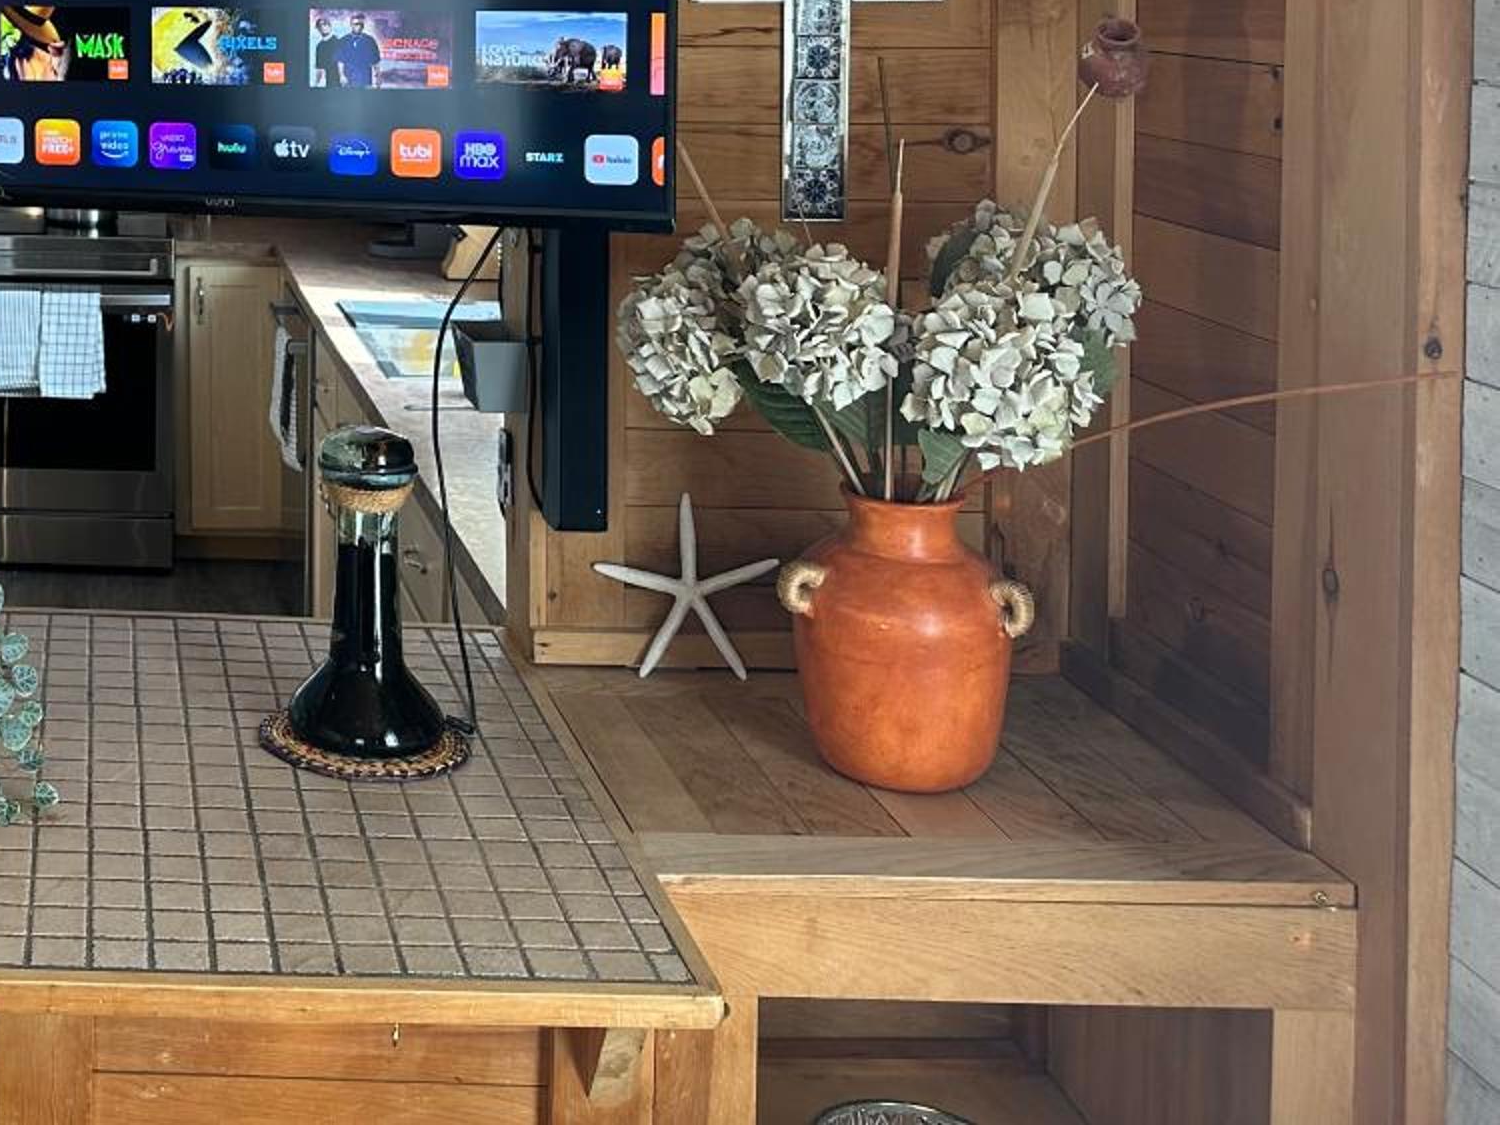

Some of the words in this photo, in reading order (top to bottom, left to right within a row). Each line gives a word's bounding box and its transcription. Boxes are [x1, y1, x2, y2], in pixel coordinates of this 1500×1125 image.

[75, 32, 125, 59] MASK
[216, 141, 247, 154] hulu
[290, 140, 310, 158] tv
[399, 142, 433, 159] tubi
[465, 142, 497, 156] HBO
[459, 154, 500, 169] max
[525, 151, 564, 163] STARZ
